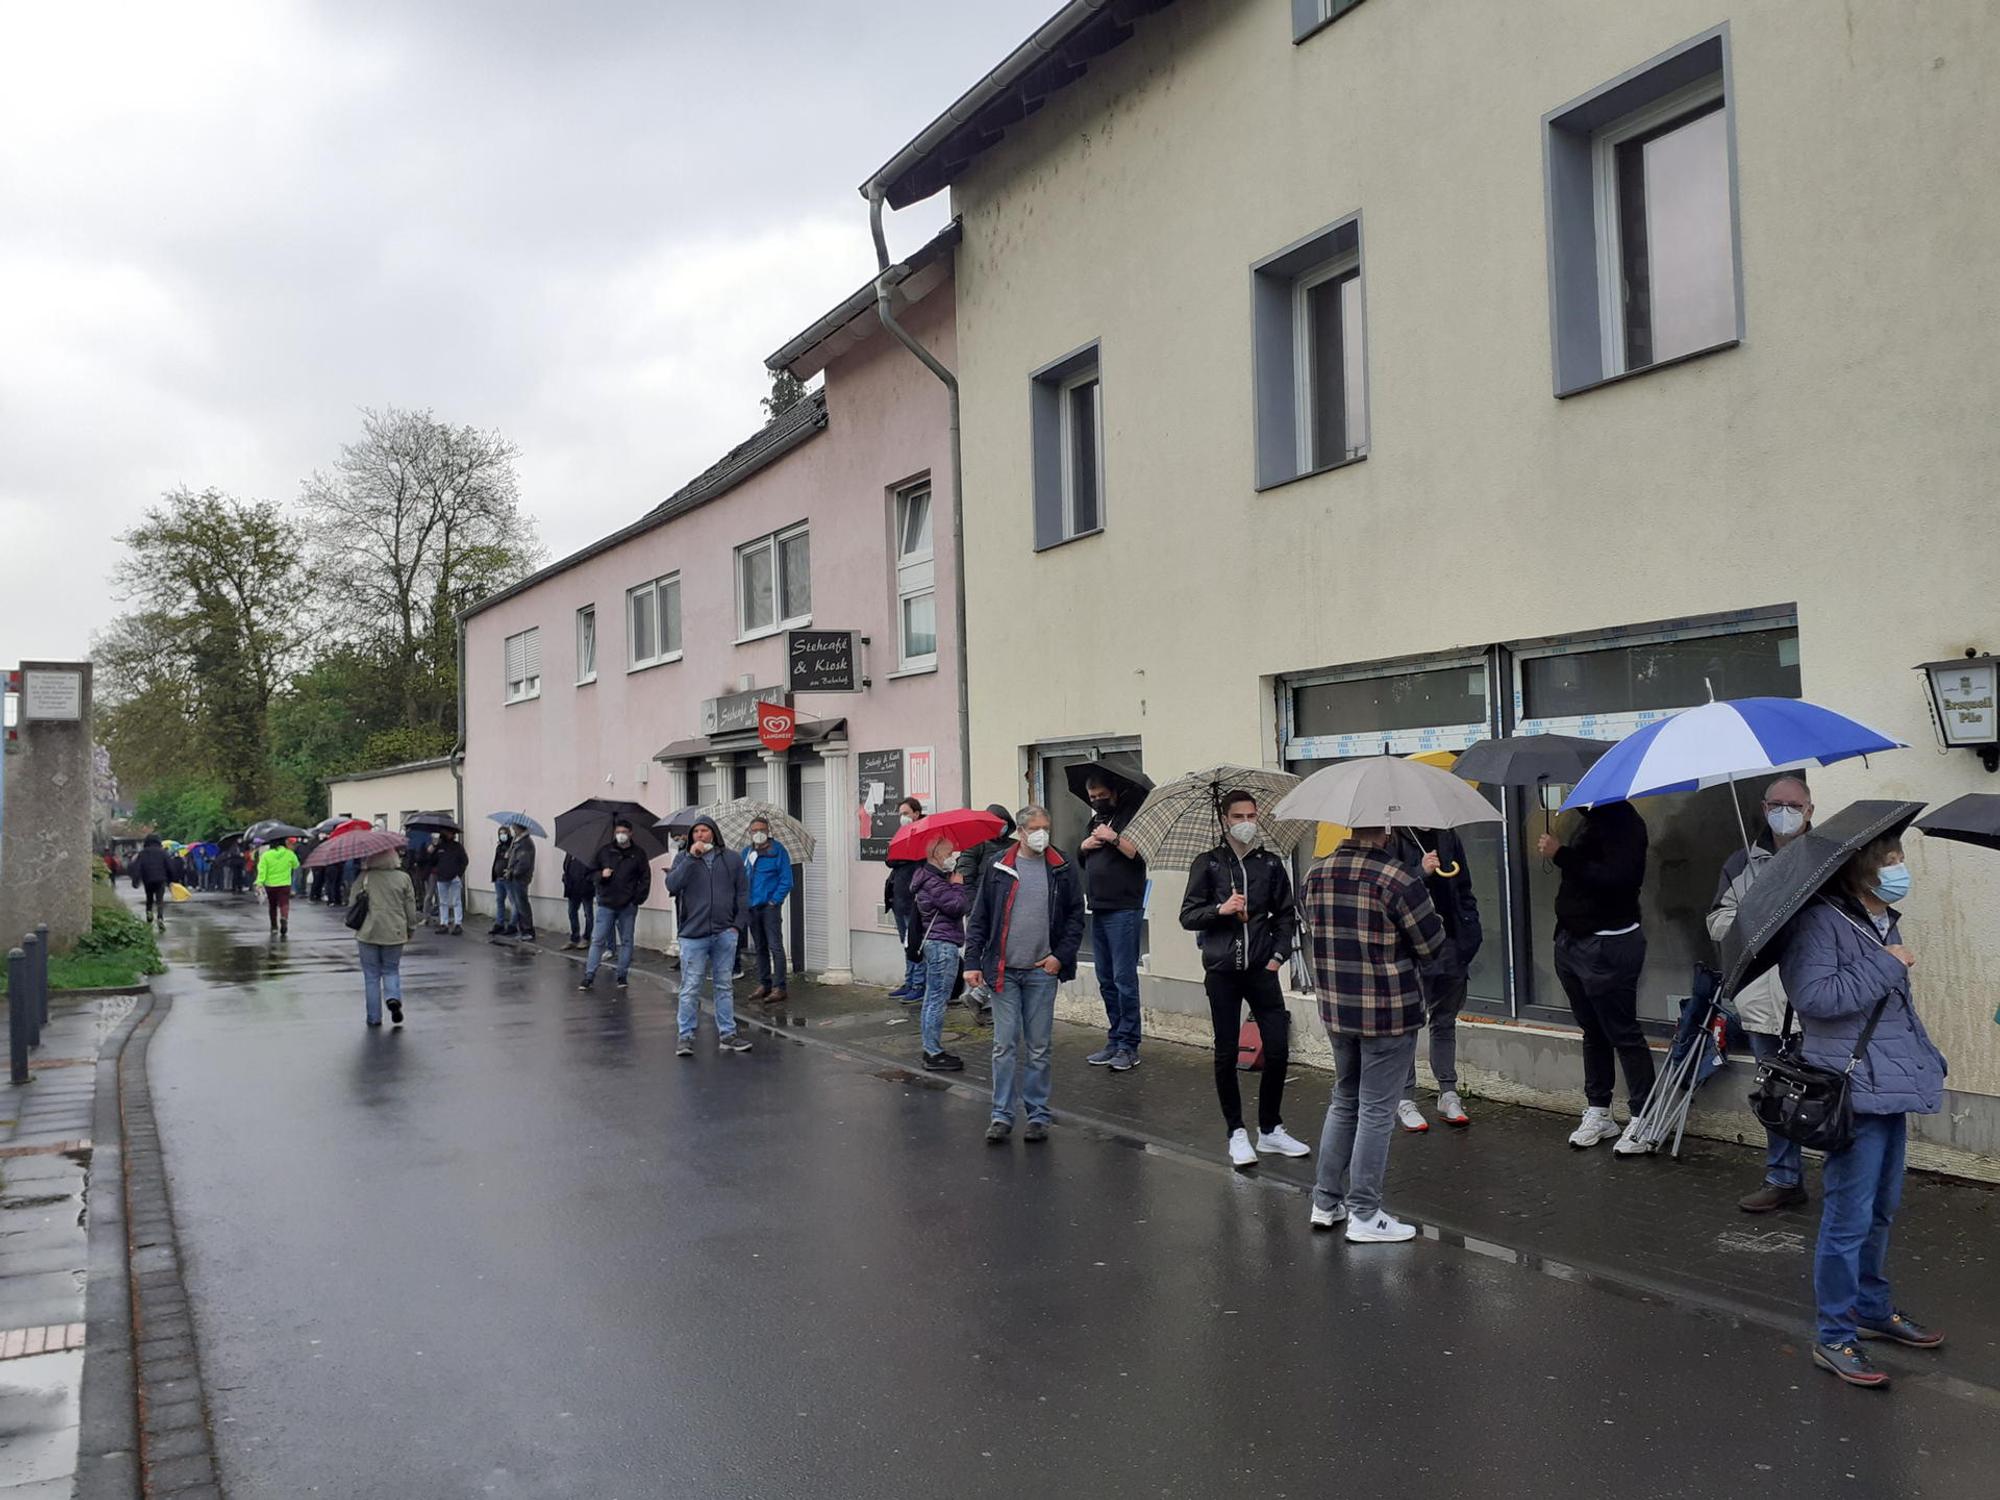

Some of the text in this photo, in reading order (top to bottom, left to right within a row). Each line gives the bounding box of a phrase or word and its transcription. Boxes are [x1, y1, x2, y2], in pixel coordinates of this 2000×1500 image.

[792, 637, 848, 656] Stehcafé
[793, 657, 848, 674] & Kiosk
[1376, 1220, 1387, 1230] N
